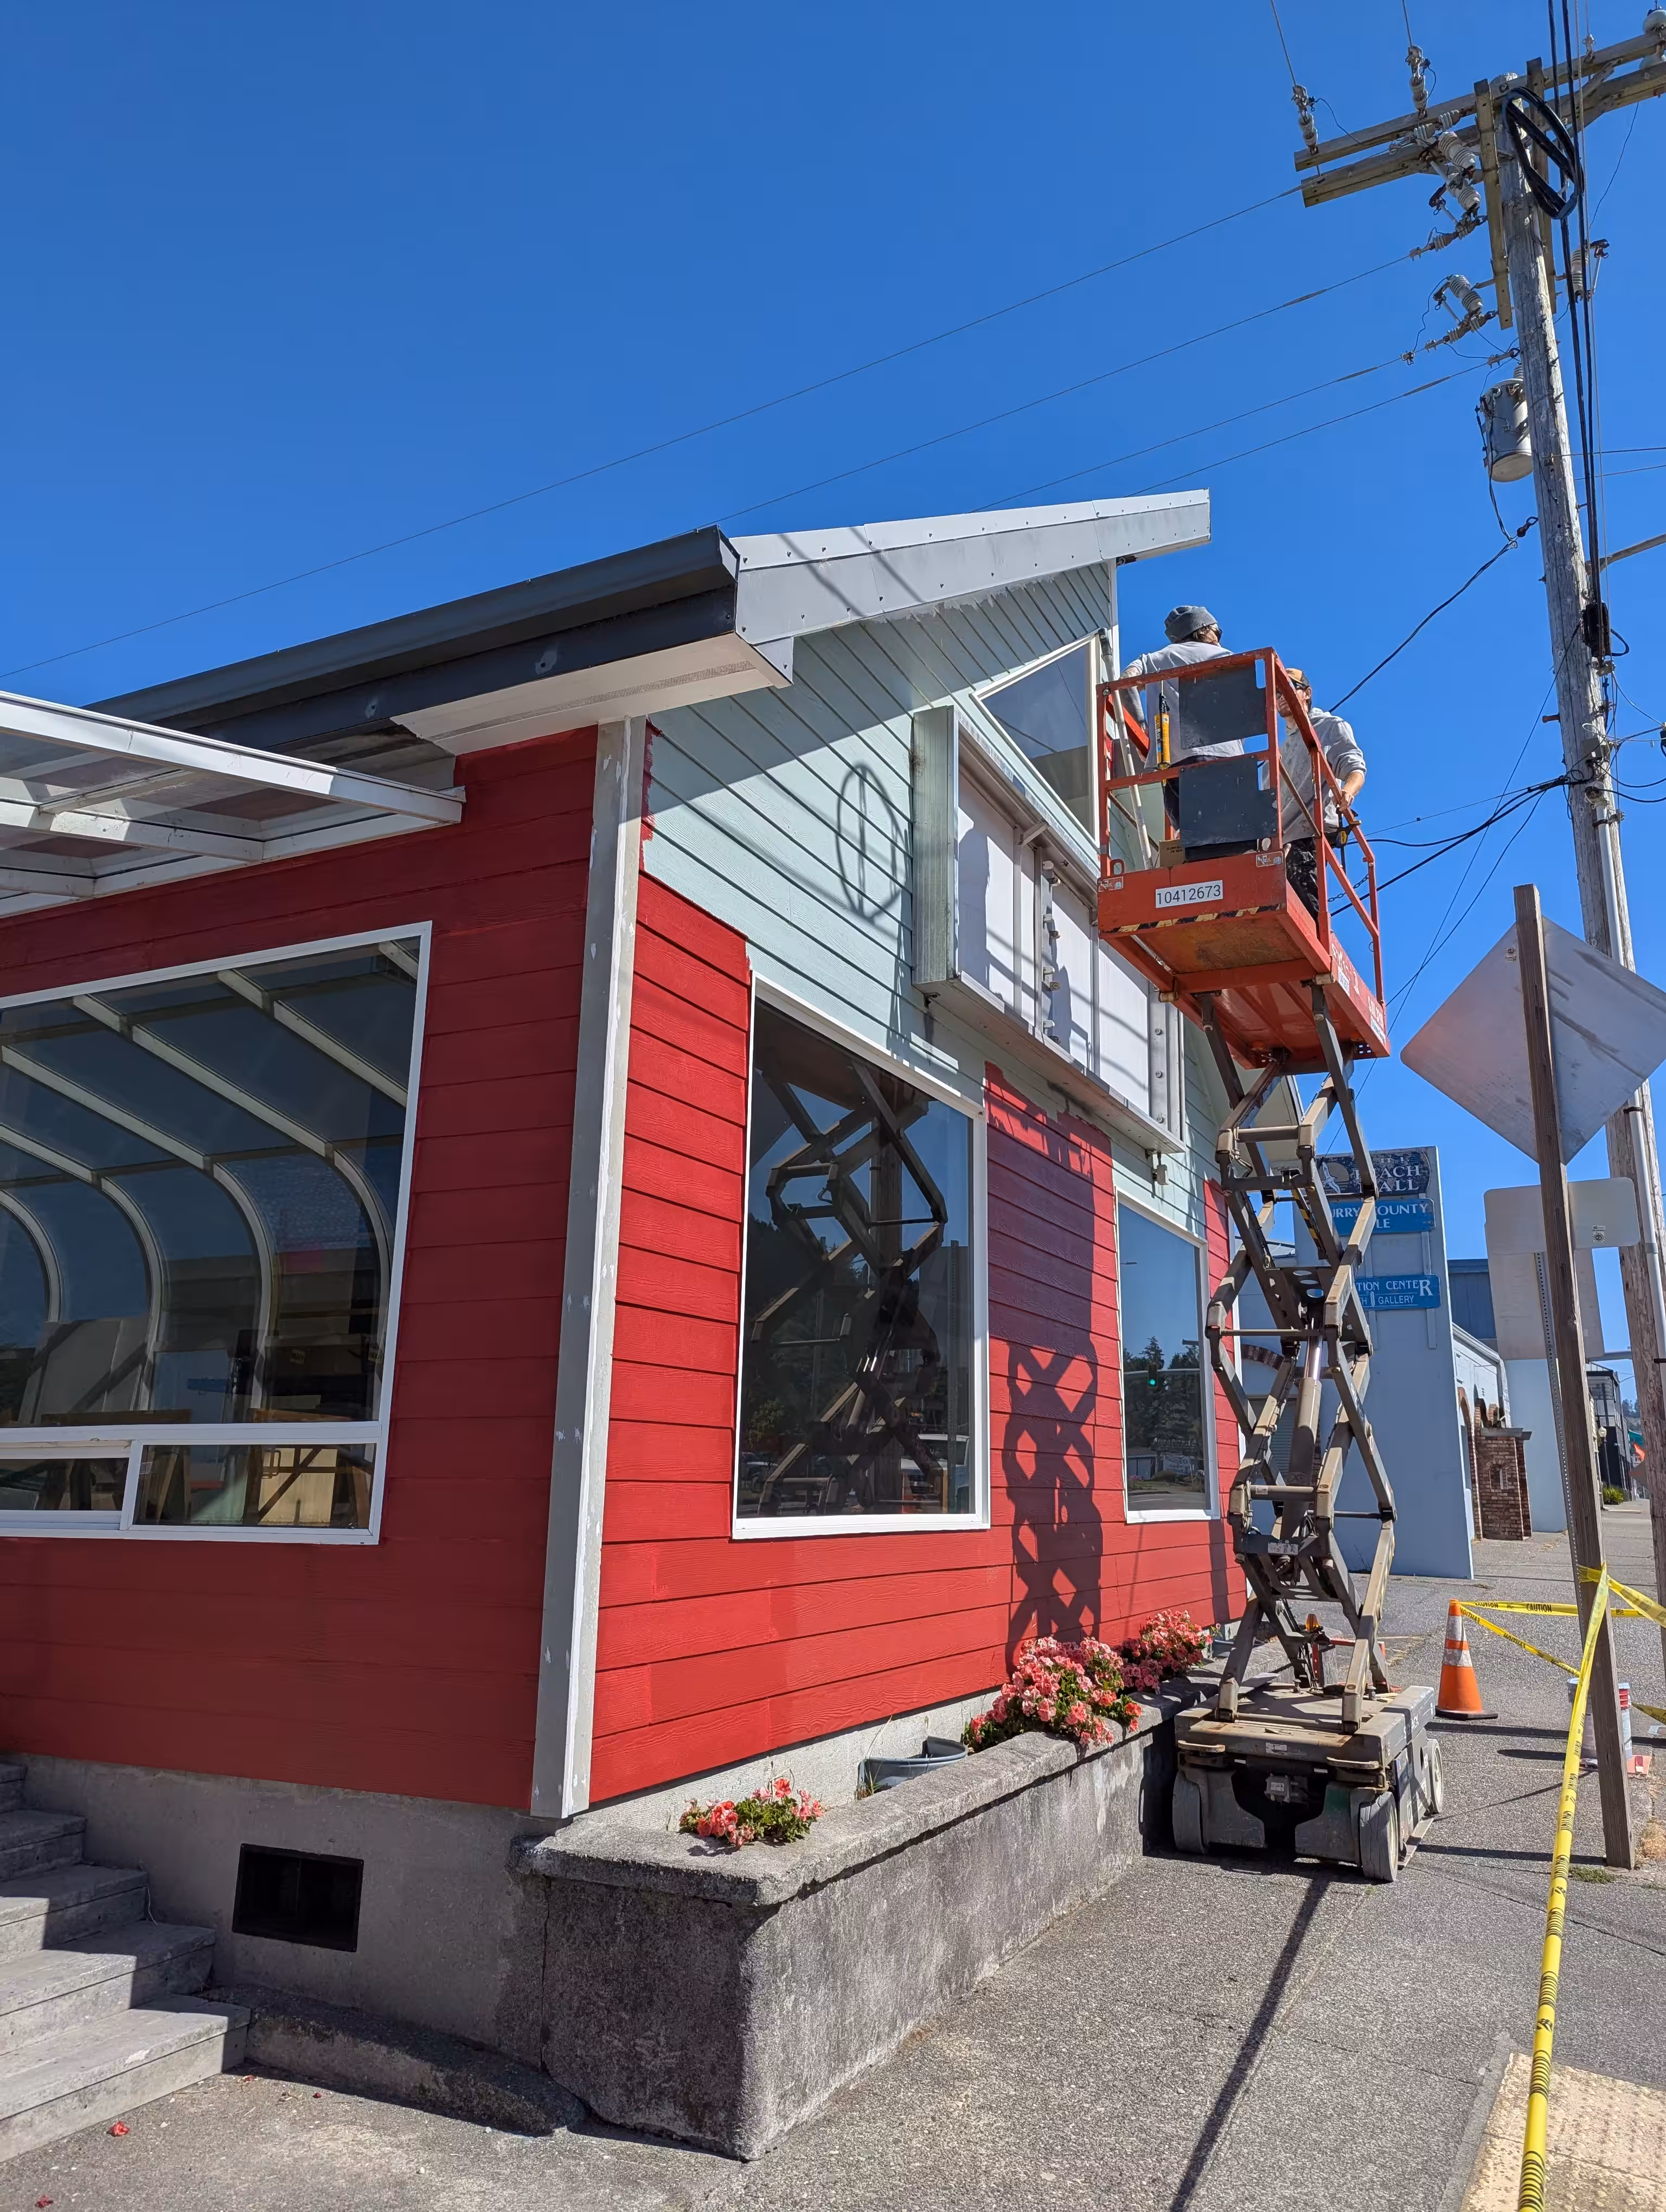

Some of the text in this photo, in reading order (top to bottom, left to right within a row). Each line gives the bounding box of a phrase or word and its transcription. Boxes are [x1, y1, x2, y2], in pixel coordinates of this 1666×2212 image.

[1157, 884, 1221, 905] 10412673
[1355, 1165, 1421, 1180] ACH
[1359, 1179, 1419, 1193] ALL
[1375, 1204, 1428, 1216] OUNTY
[1386, 1279, 1433, 1296] CENTER
[1378, 1295, 1414, 1304] GALLERY
[1526, 1603, 1552, 1612] CAUTION
